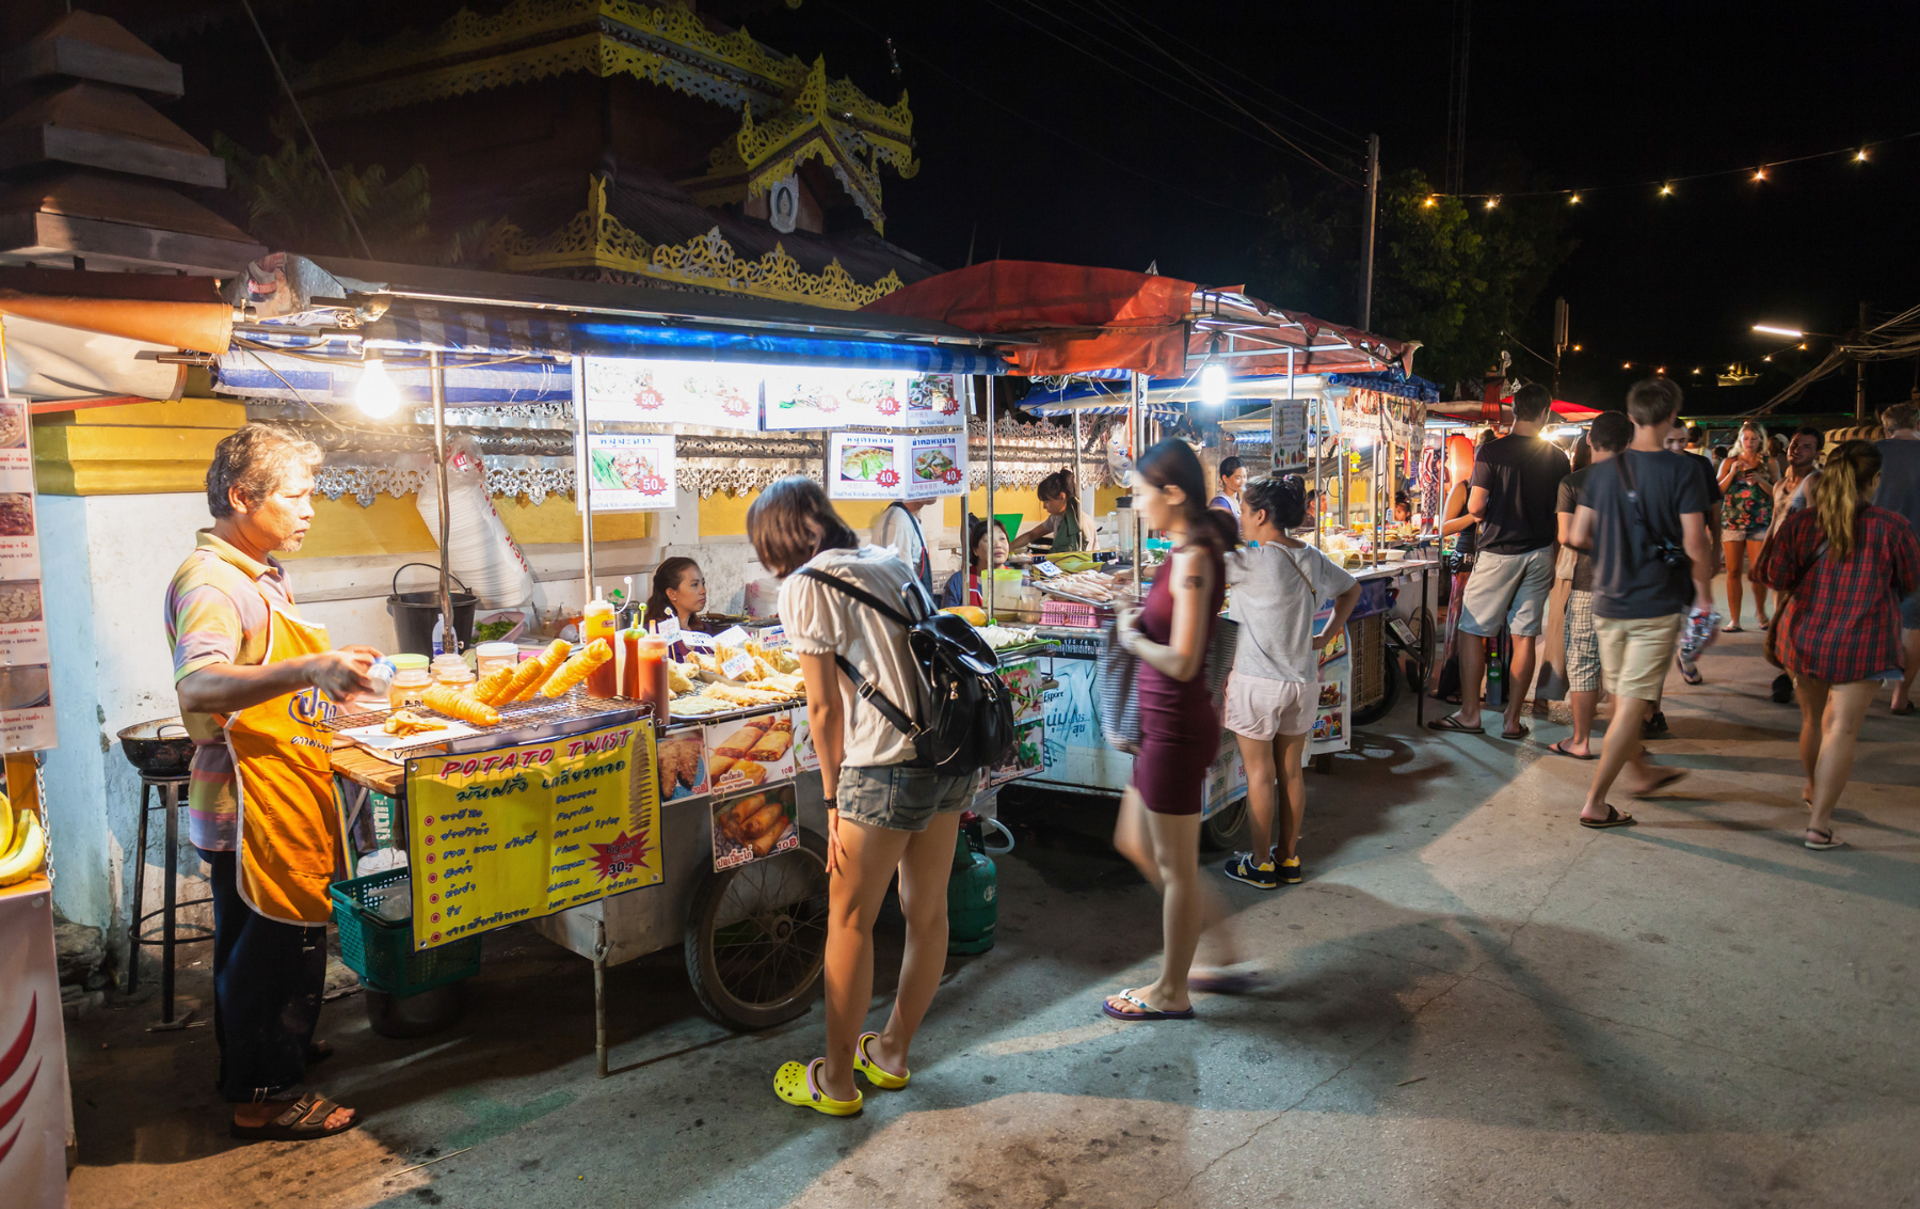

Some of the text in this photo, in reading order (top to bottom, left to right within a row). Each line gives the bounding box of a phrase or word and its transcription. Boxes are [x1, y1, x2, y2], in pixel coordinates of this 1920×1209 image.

[641, 393, 659, 406] 50.
[880, 401, 896, 411] 40.
[880, 472, 896, 483] 40.
[945, 470, 959, 481] 40.
[643, 478, 663, 490] 50.
[440, 728, 634, 779] POTATO TWIST
[456, 759, 627, 802] มันฝรั่ง เกลียวทอด
[556, 805, 594, 822] Paprika
[553, 816, 621, 840] Hot and Spicy
[555, 843, 580, 857] Pizza
[606, 839, 638, 855] Big size
[608, 860, 634, 876] 30.-
[546, 878, 580, 893] Cheese
